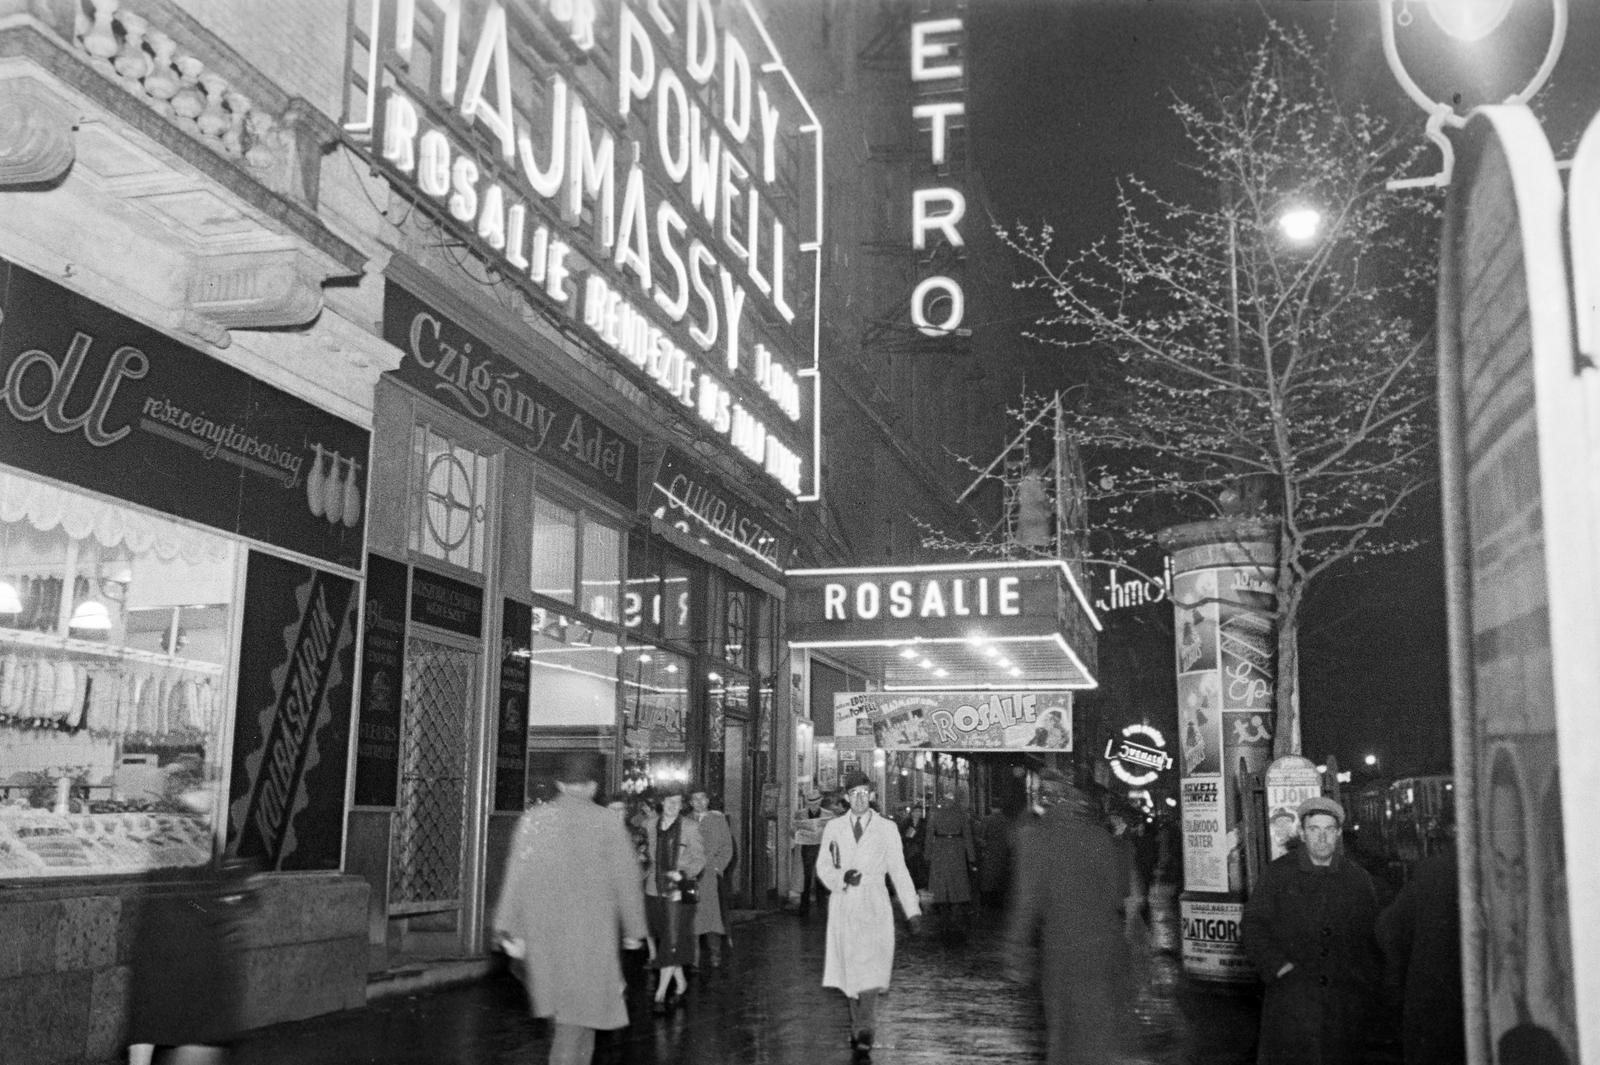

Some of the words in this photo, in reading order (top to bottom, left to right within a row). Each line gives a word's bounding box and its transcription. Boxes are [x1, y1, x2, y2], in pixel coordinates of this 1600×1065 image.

[382, 93, 569, 302] ROSALIE
[619, 5, 795, 325] POWELL
[408, 311, 556, 452] Czigány
[824, 576, 1020, 621] ROSALIE
[930, 694, 1037, 744] ROSALIE
